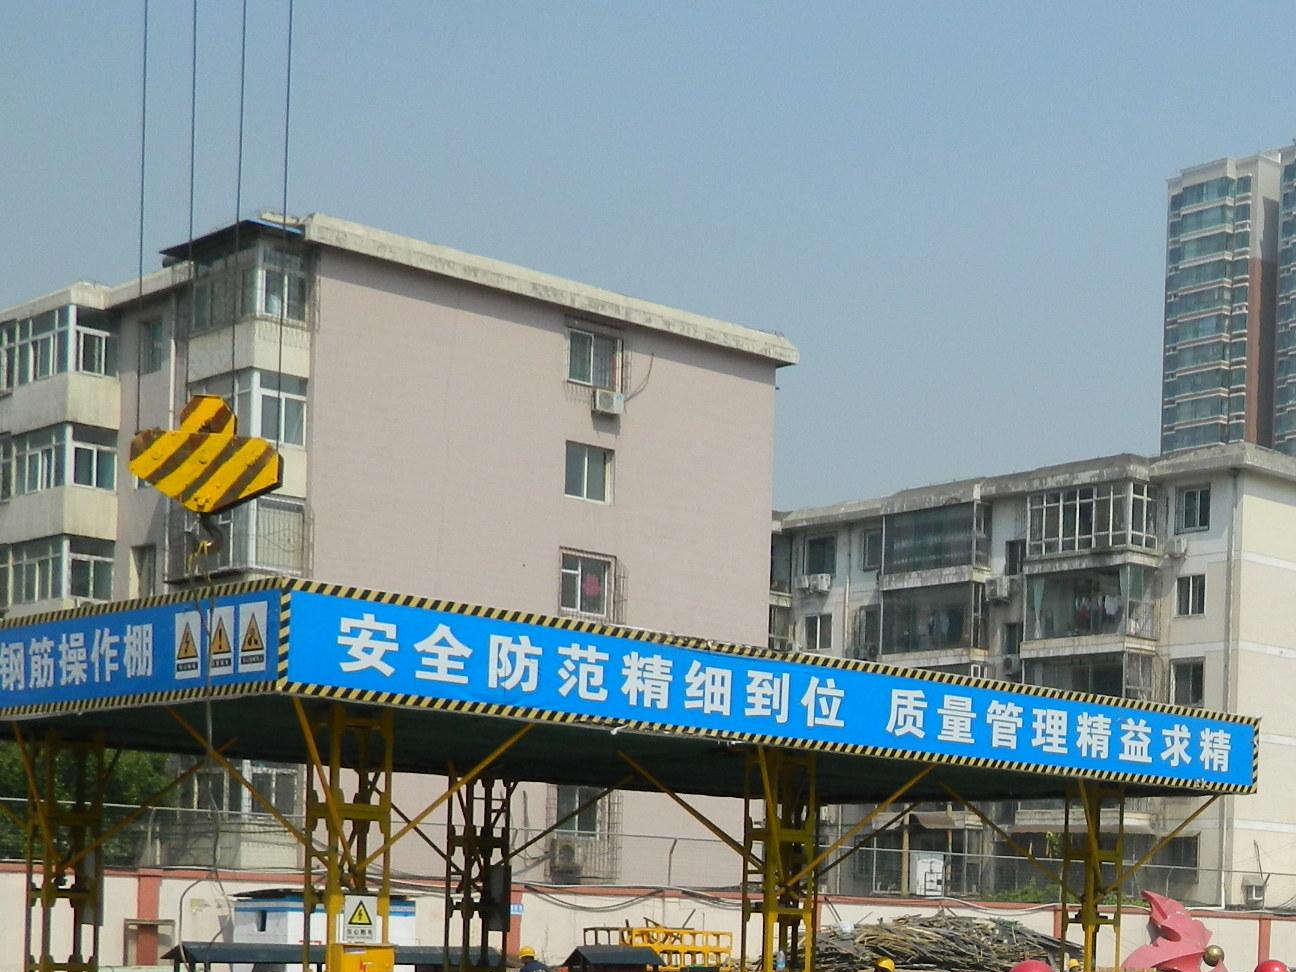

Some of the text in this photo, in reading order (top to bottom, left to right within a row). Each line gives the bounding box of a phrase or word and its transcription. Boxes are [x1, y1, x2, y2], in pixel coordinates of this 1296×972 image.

[0, 623, 153, 691] 钢筋操作棚
[337, 613, 1232, 772] 安全防范精细到位 质量管理精益求精
